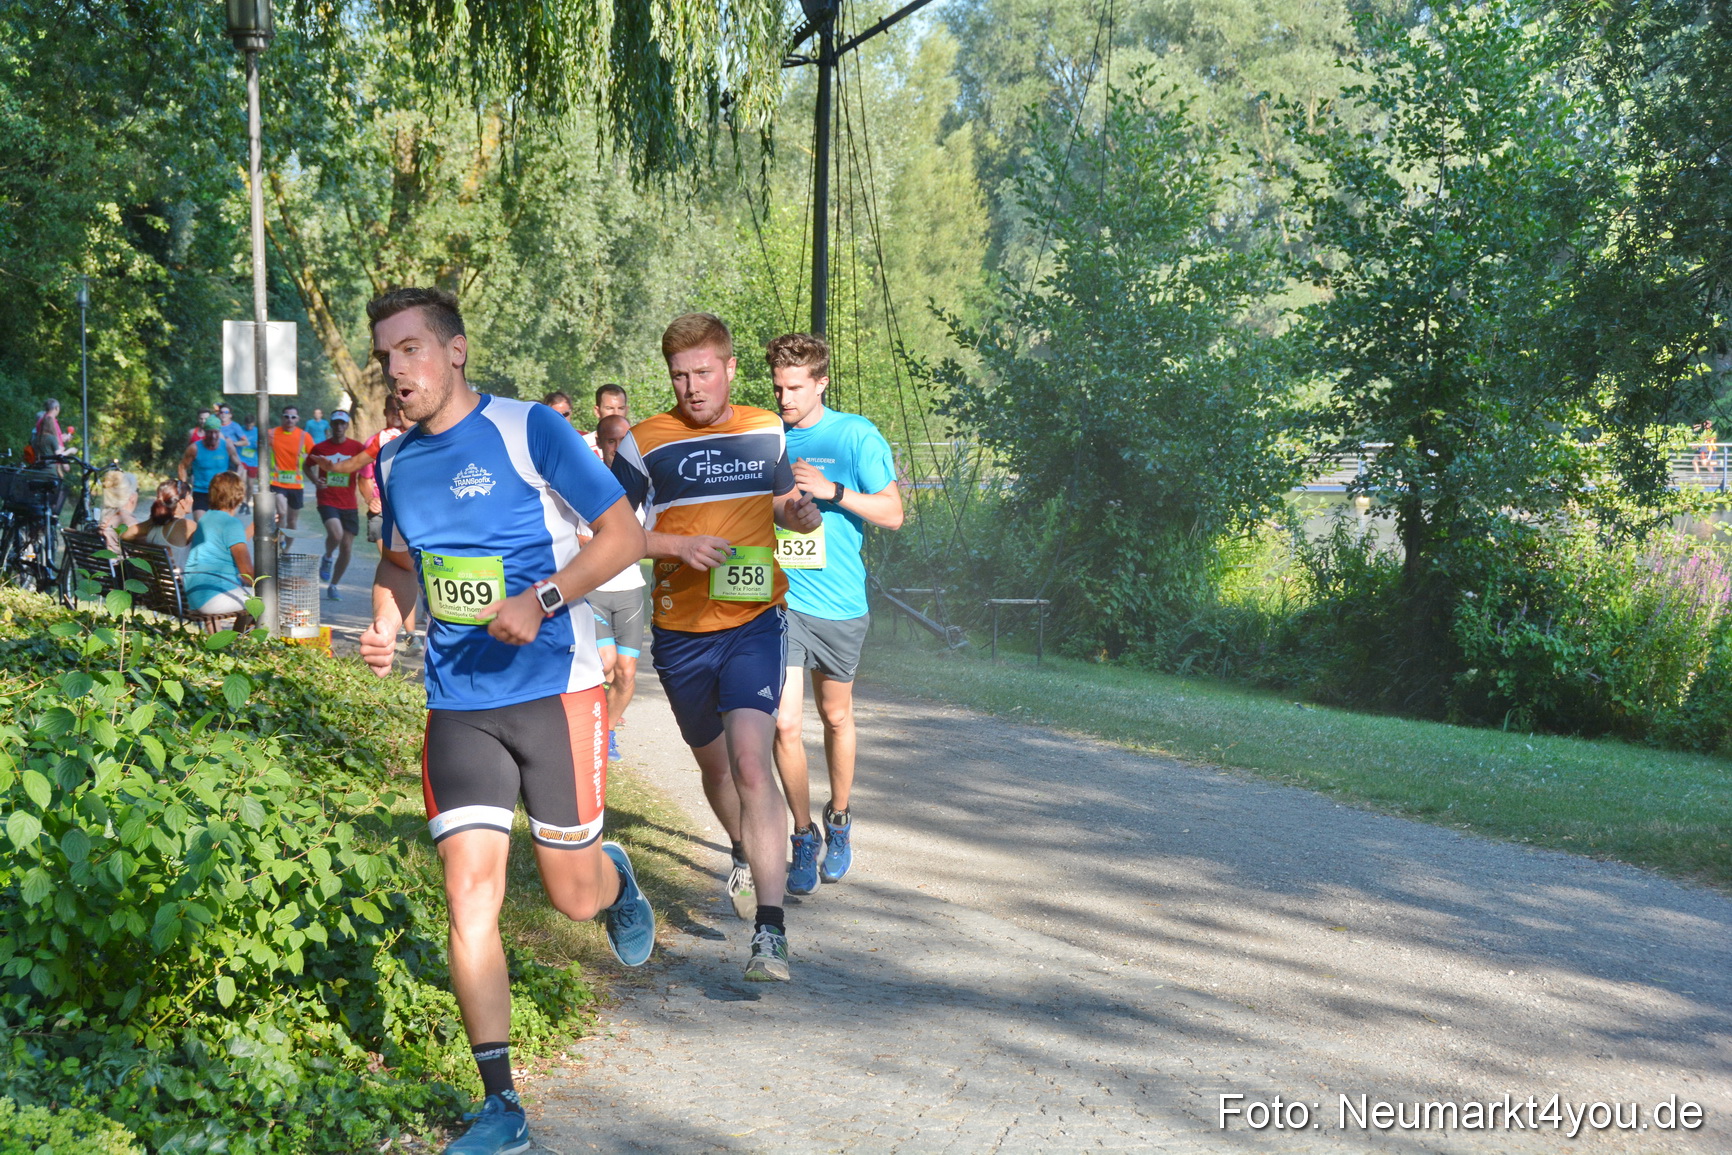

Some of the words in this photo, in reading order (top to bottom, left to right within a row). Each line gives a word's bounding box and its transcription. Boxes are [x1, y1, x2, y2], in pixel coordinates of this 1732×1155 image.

[696, 458, 766, 476] Fischer
[704, 472, 763, 484] AUTOMOBILE
[776, 539, 816, 556] 1532
[726, 566, 765, 586] 558
[433, 577, 493, 606] 1969
[439, 602, 462, 612] Schmidt
[462, 605, 484, 613] Thom
[592, 701, 604, 808] arndt-gruppe.de
